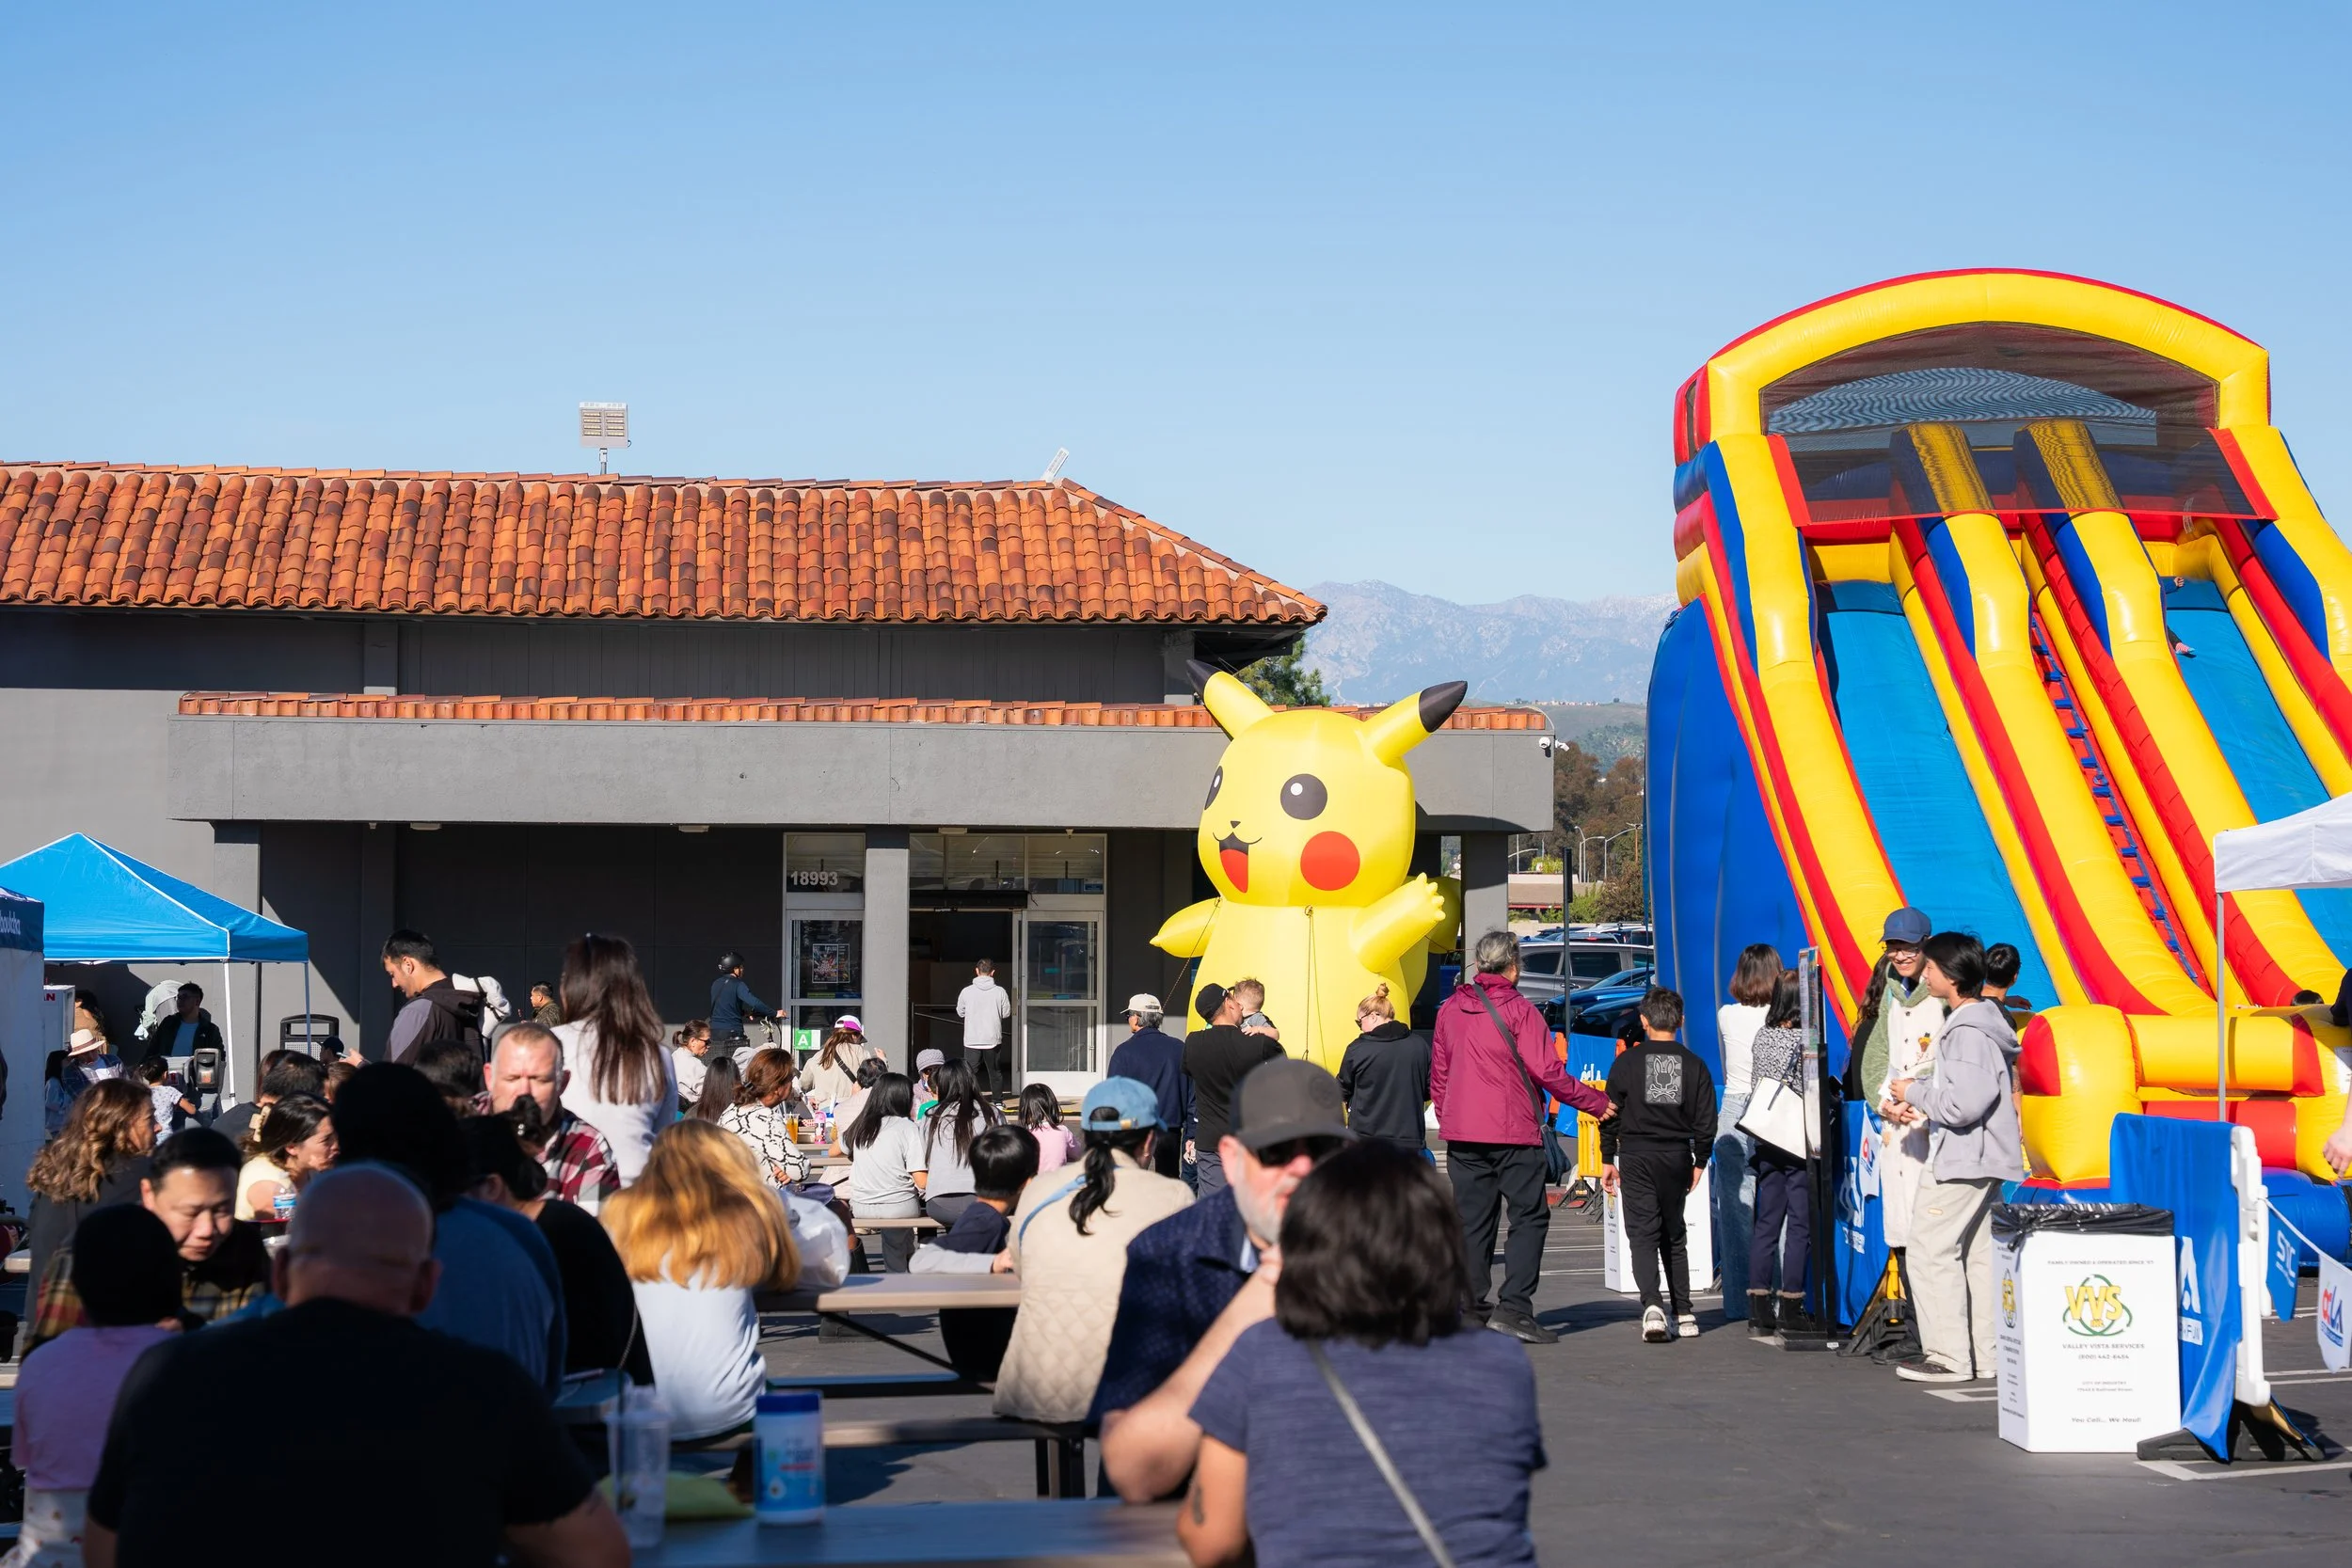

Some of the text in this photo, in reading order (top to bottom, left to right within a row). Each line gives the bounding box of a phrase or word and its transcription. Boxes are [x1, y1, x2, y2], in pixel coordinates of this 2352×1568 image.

[790, 871, 838, 886] 18993
[797, 1034, 809, 1046] A
[2064, 1286, 2124, 1321] VVS
